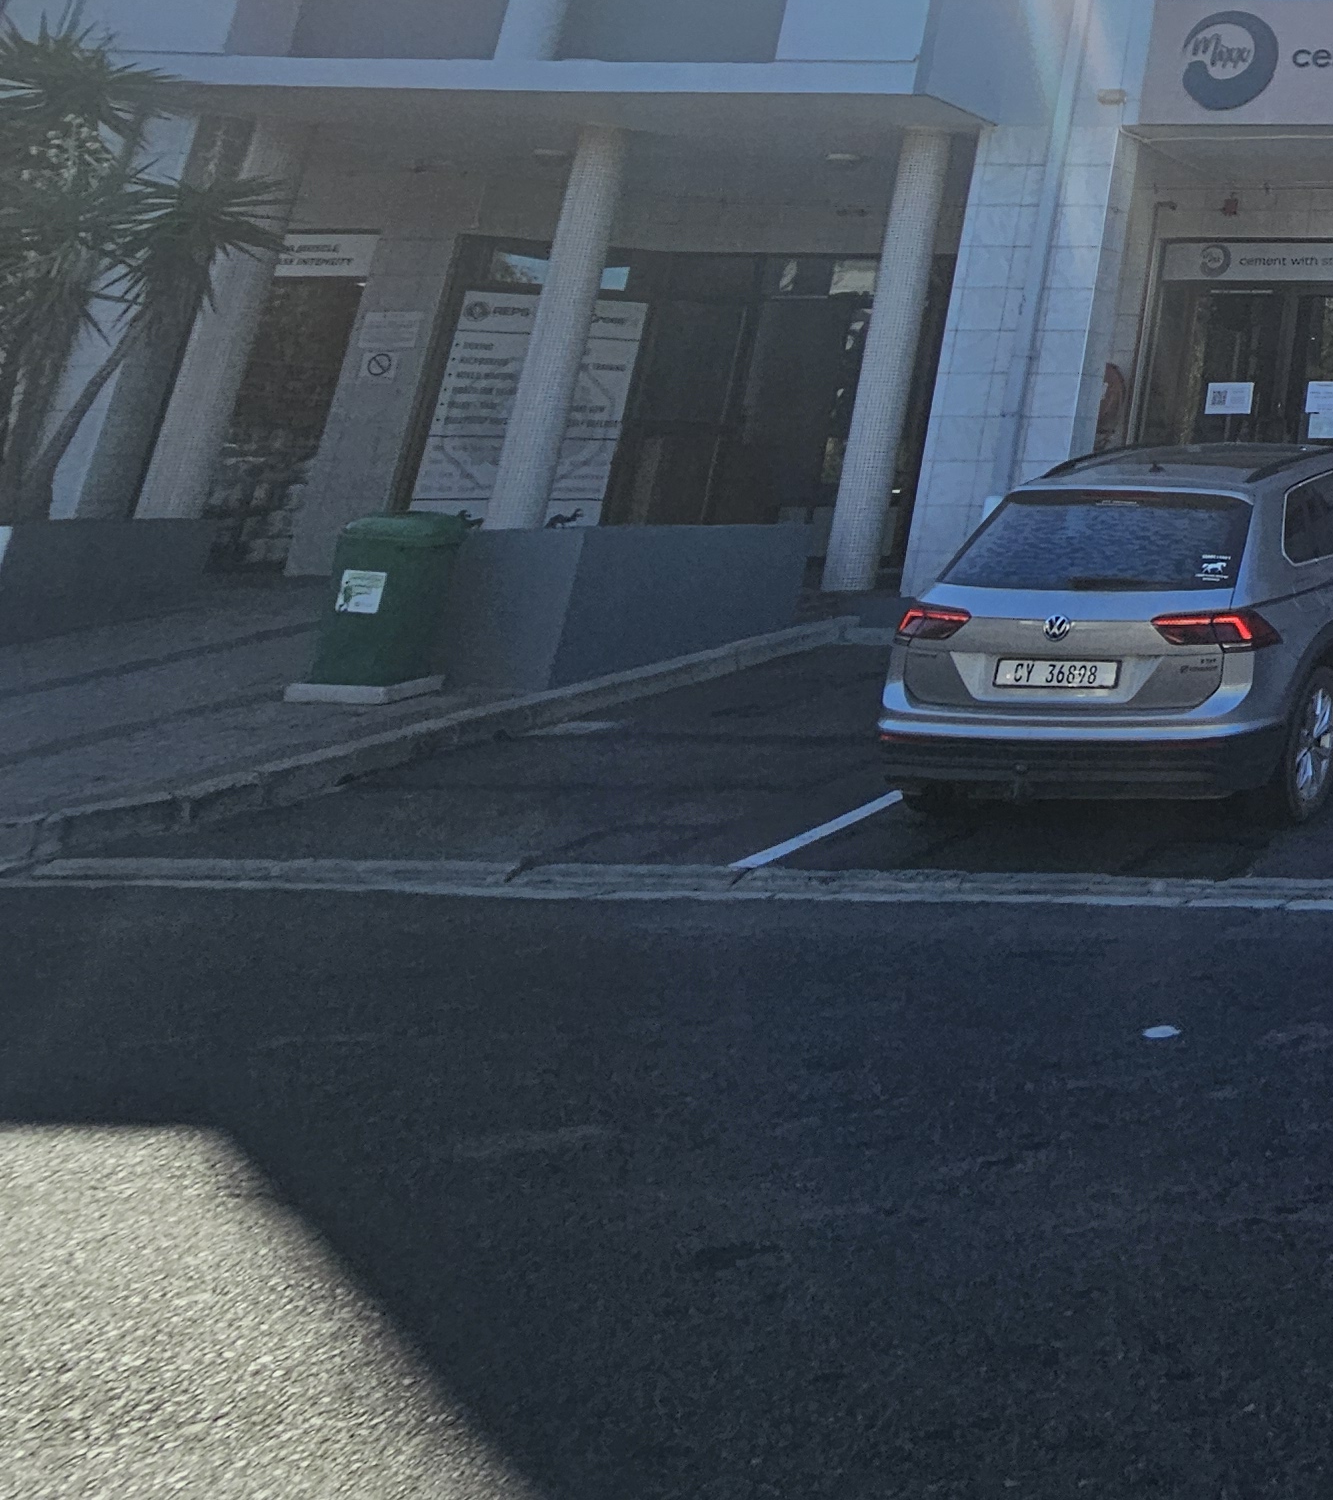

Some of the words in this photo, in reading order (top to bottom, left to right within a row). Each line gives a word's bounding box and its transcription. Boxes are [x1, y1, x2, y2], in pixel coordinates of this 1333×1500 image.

[1239, 256, 1287, 266] cement
[1291, 256, 1319, 266] with
[1014, 663, 1034, 683] CY
